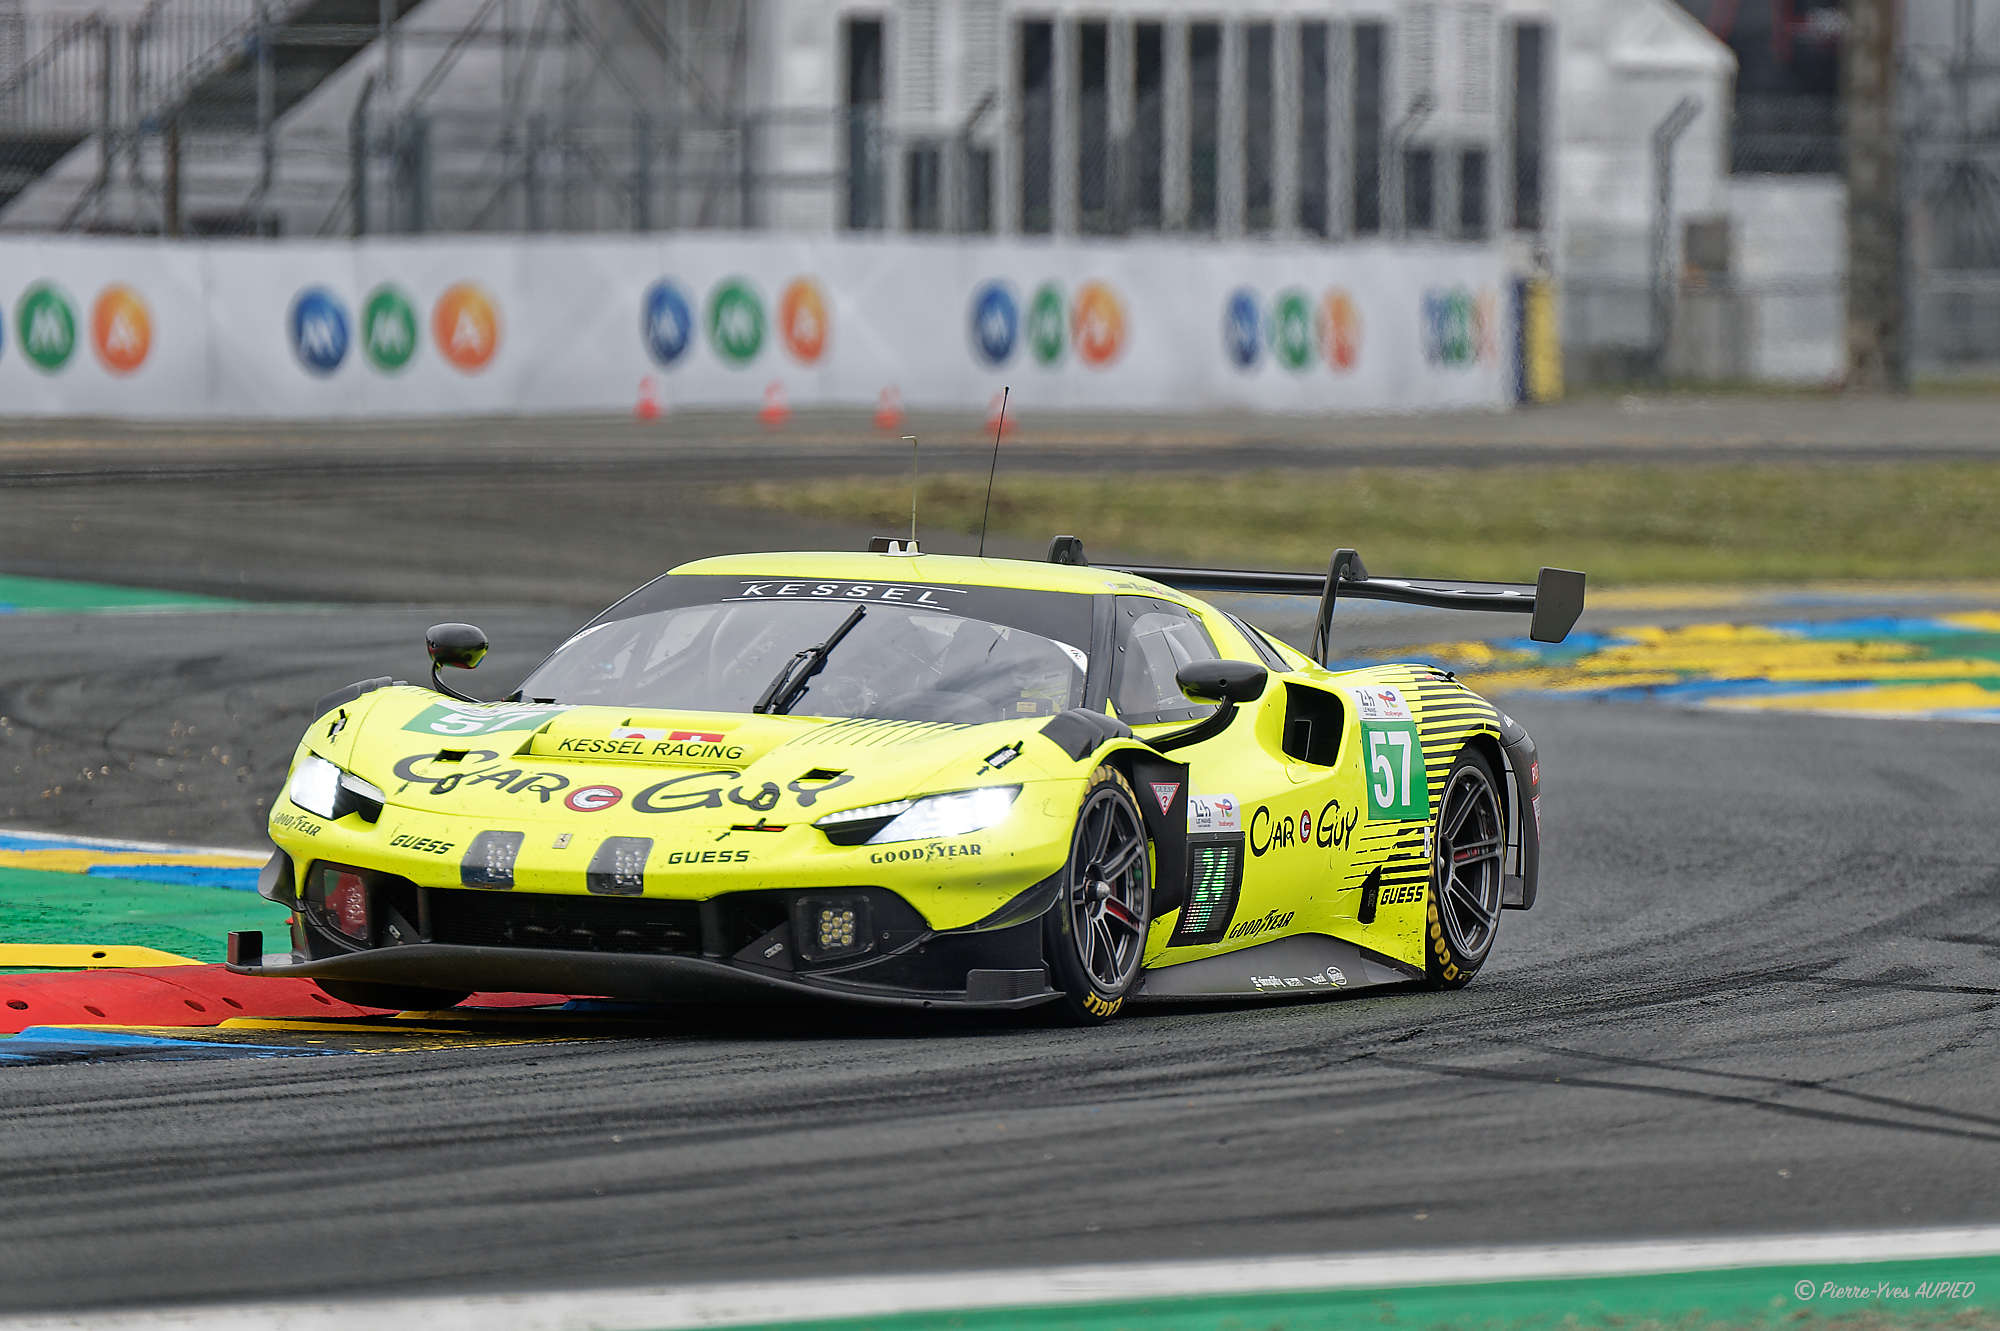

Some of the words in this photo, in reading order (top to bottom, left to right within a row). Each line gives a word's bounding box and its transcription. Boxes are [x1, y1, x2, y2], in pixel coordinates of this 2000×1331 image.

[741, 583, 939, 604] KESSEL
[430, 711, 547, 734] 57
[558, 738, 645, 757] KESSEL
[651, 742, 743, 761] RACING
[1369, 730, 1412, 808] 57
[390, 834, 455, 855] GUESS
[668, 850, 750, 865] GUESS
[1379, 885, 1424, 906] GUESS
